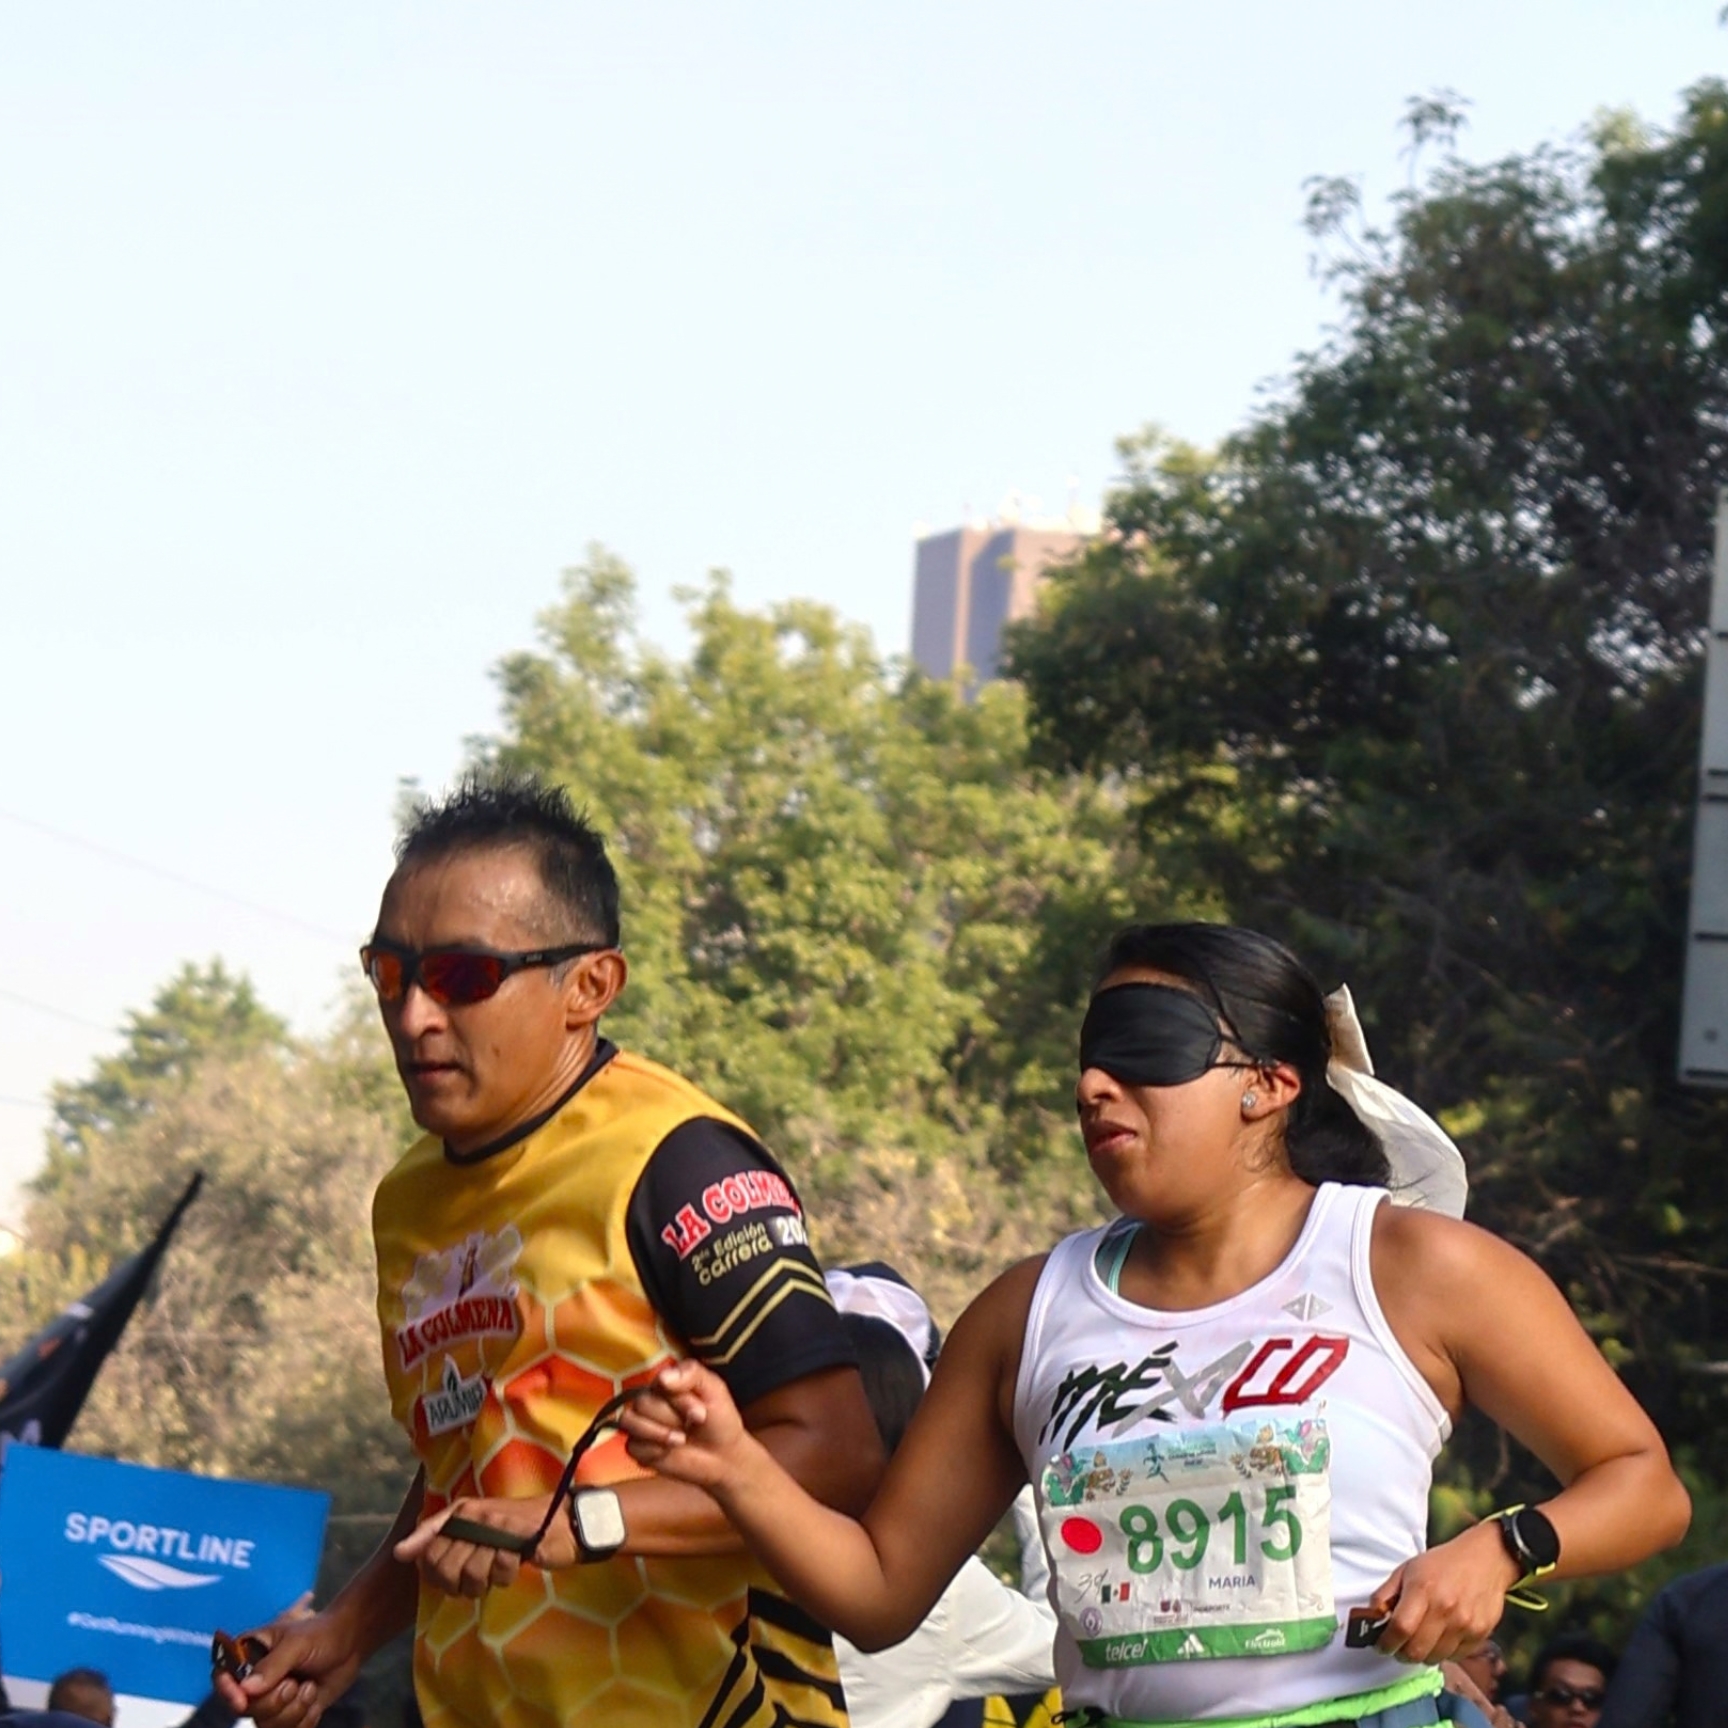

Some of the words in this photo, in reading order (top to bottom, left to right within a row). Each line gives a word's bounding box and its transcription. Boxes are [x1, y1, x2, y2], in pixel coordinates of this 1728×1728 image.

[661, 1202, 712, 1262] LA
[699, 1233, 773, 1286] carrera
[713, 1221, 767, 1257] Edición
[398, 1323, 425, 1369] LA
[421, 1298, 515, 1346] COLMENA
[65, 1511, 256, 1570] SPORTLINE
[1119, 1485, 1302, 1574] 8915
[1208, 1574, 1256, 1590] MARIA
[1105, 1637, 1149, 1662] telcel
